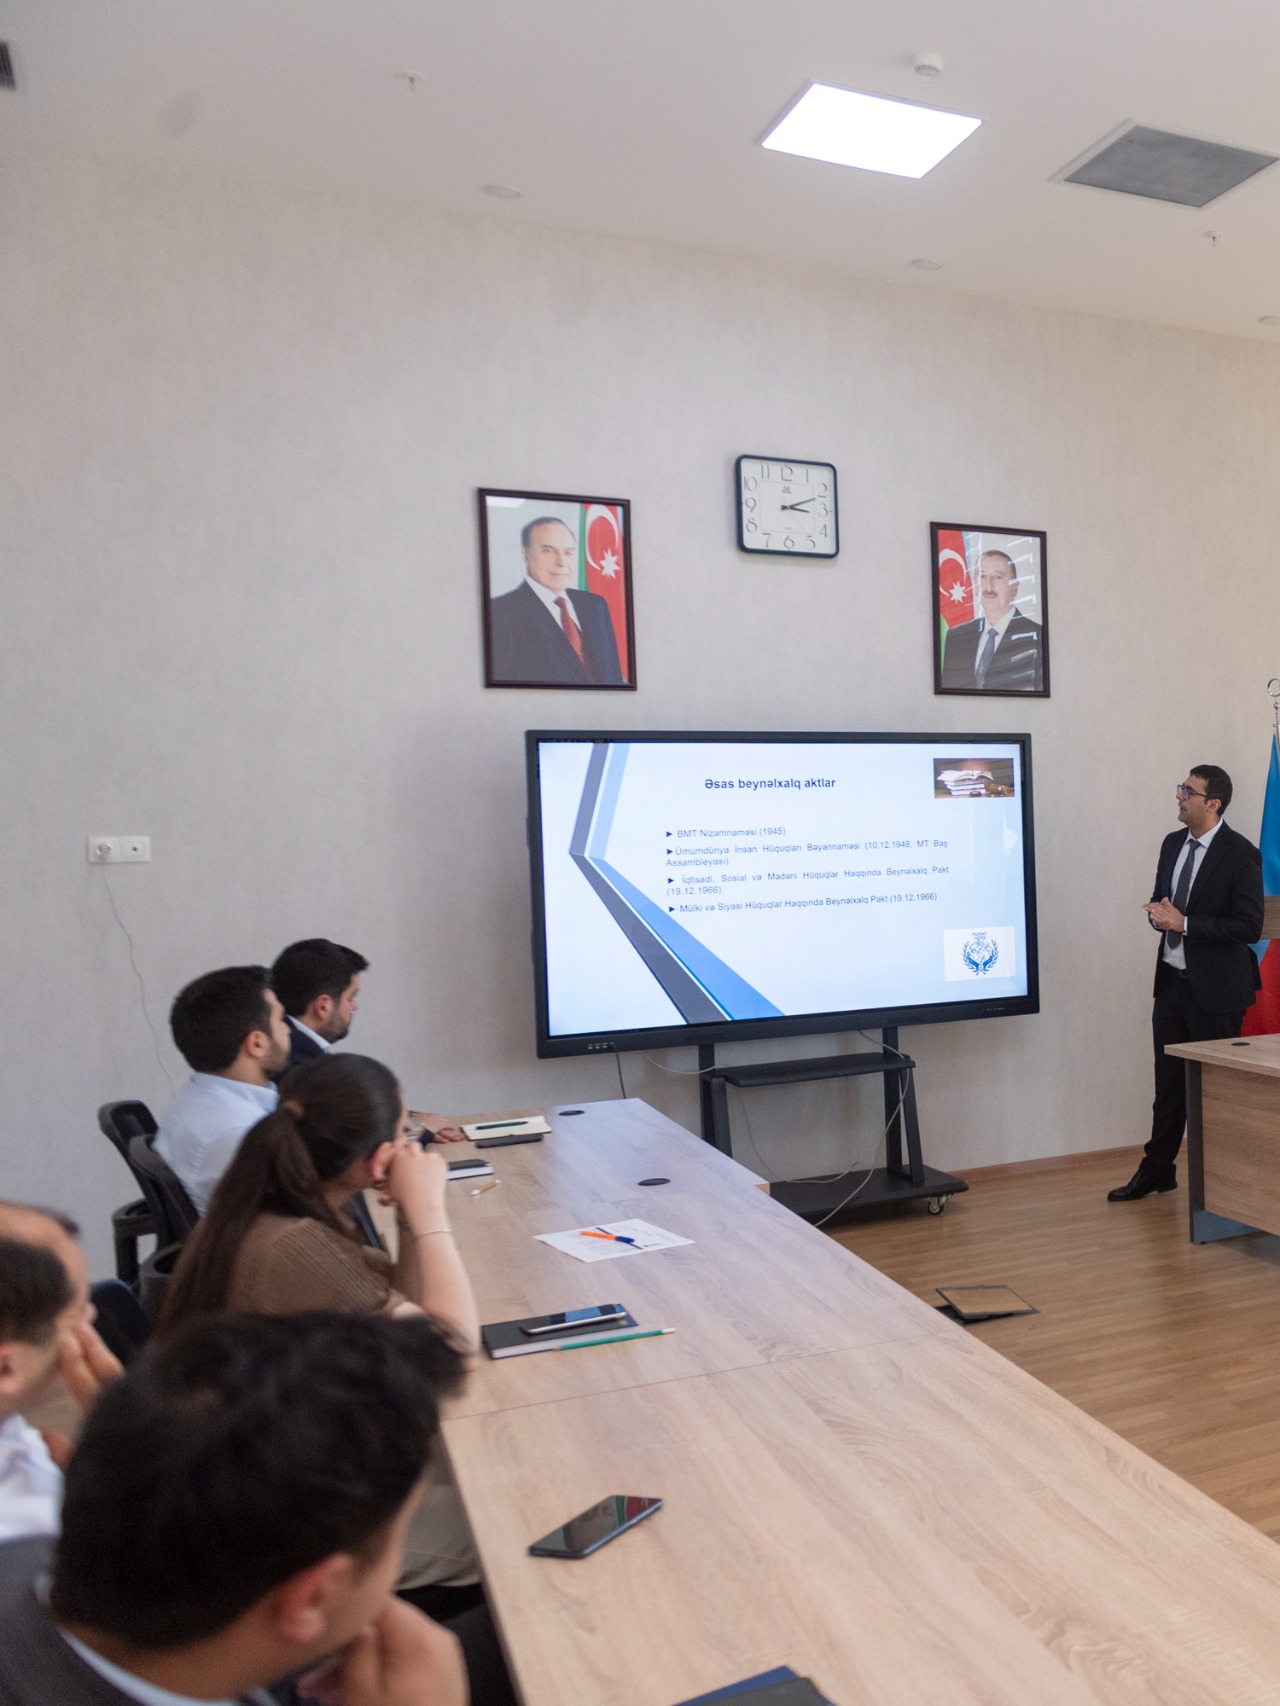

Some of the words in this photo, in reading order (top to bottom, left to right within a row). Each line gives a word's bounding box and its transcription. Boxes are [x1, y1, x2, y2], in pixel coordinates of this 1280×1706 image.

[705, 779, 735, 790] Əsas
[738, 778, 801, 791] beynəlxalq
[804, 778, 836, 788] aktlar
[677, 829, 697, 838] BMT
[700, 828, 757, 837] Nizamnaməsi
[759, 827, 786, 837] (1945)
[916, 839, 929, 848] MT
[721, 873, 747, 882] Sosial
[767, 871, 797, 880] Mədəni
[932, 866, 949, 874] Pakt
[717, 902, 743, 912] Siyasi
[870, 894, 888, 903] Pakt
